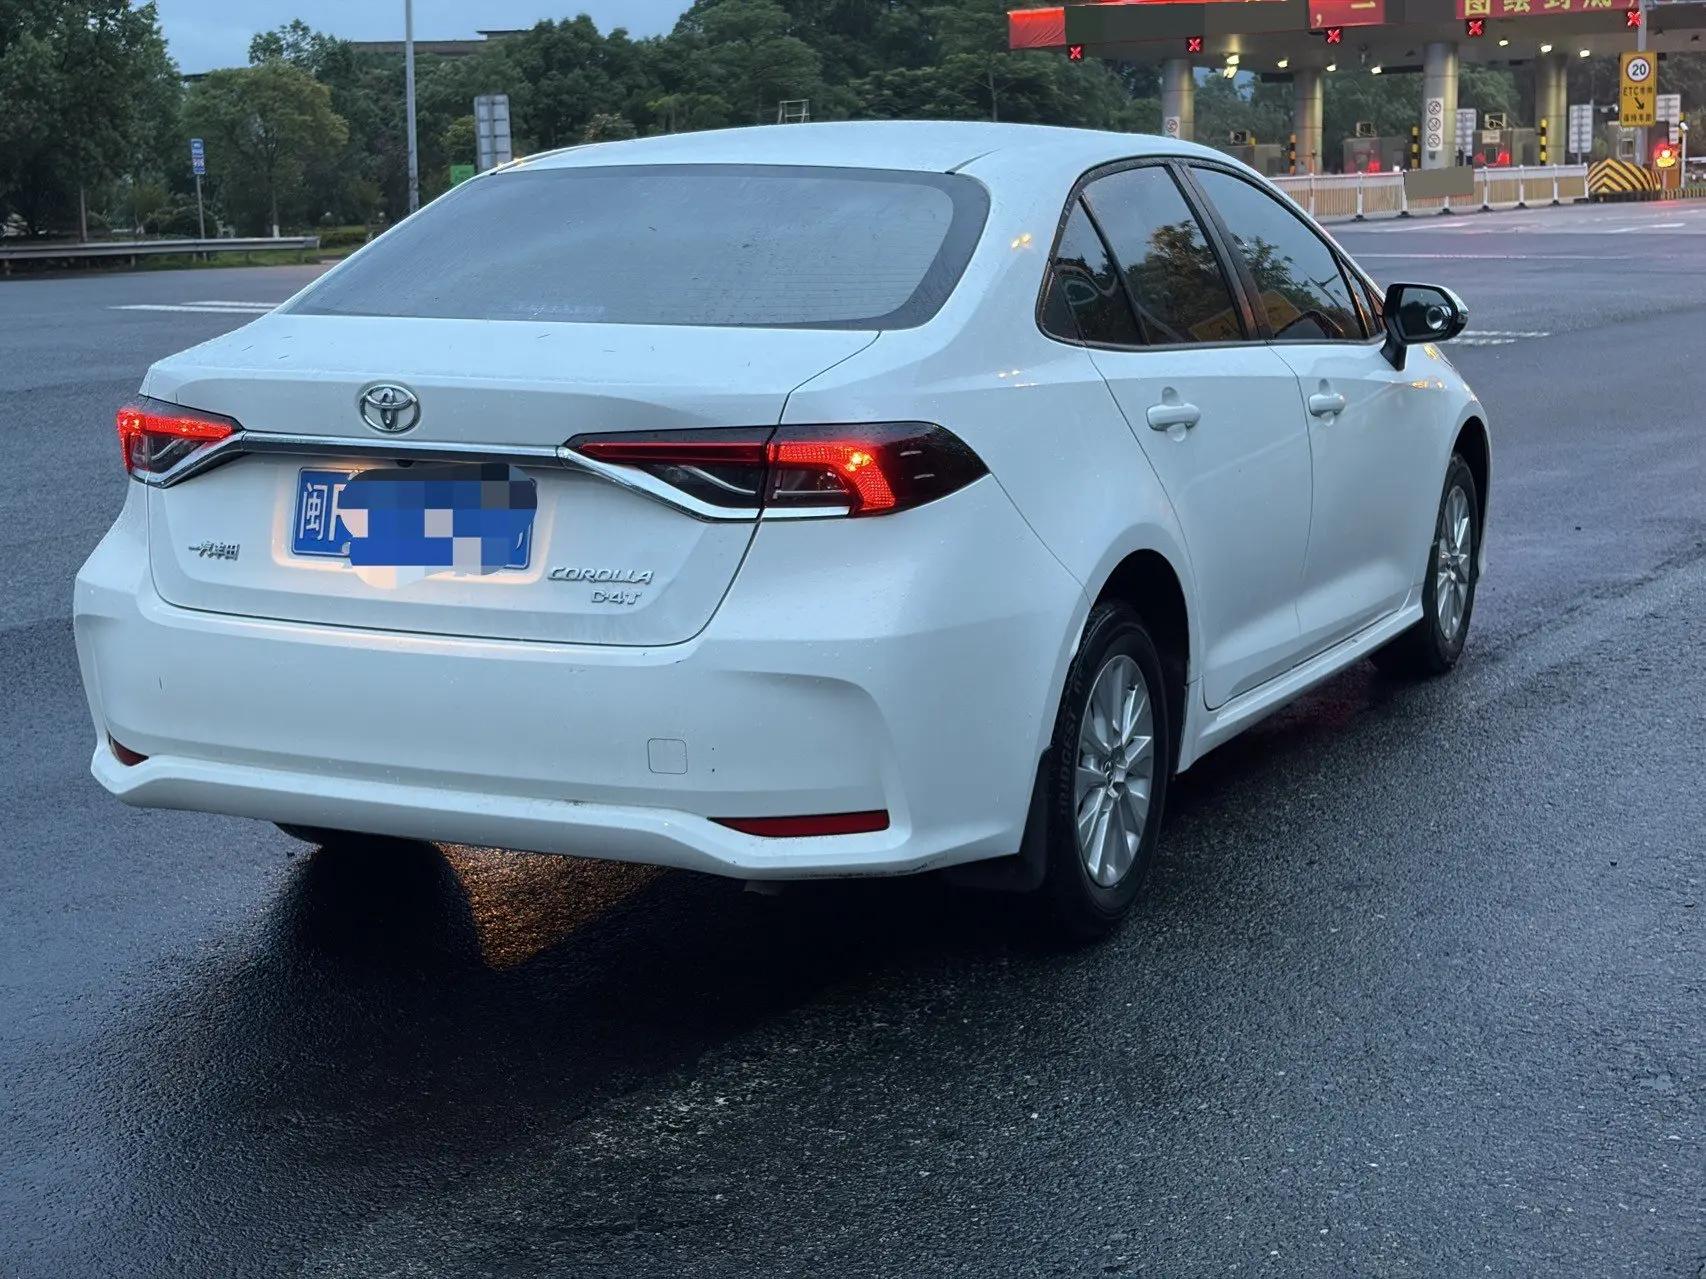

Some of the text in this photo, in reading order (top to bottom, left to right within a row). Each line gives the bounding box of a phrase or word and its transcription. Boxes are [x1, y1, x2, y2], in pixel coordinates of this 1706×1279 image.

[1632, 64, 1647, 76] 20
[1623, 86, 1653, 97] ETC
[548, 566, 654, 585] COROLLA
